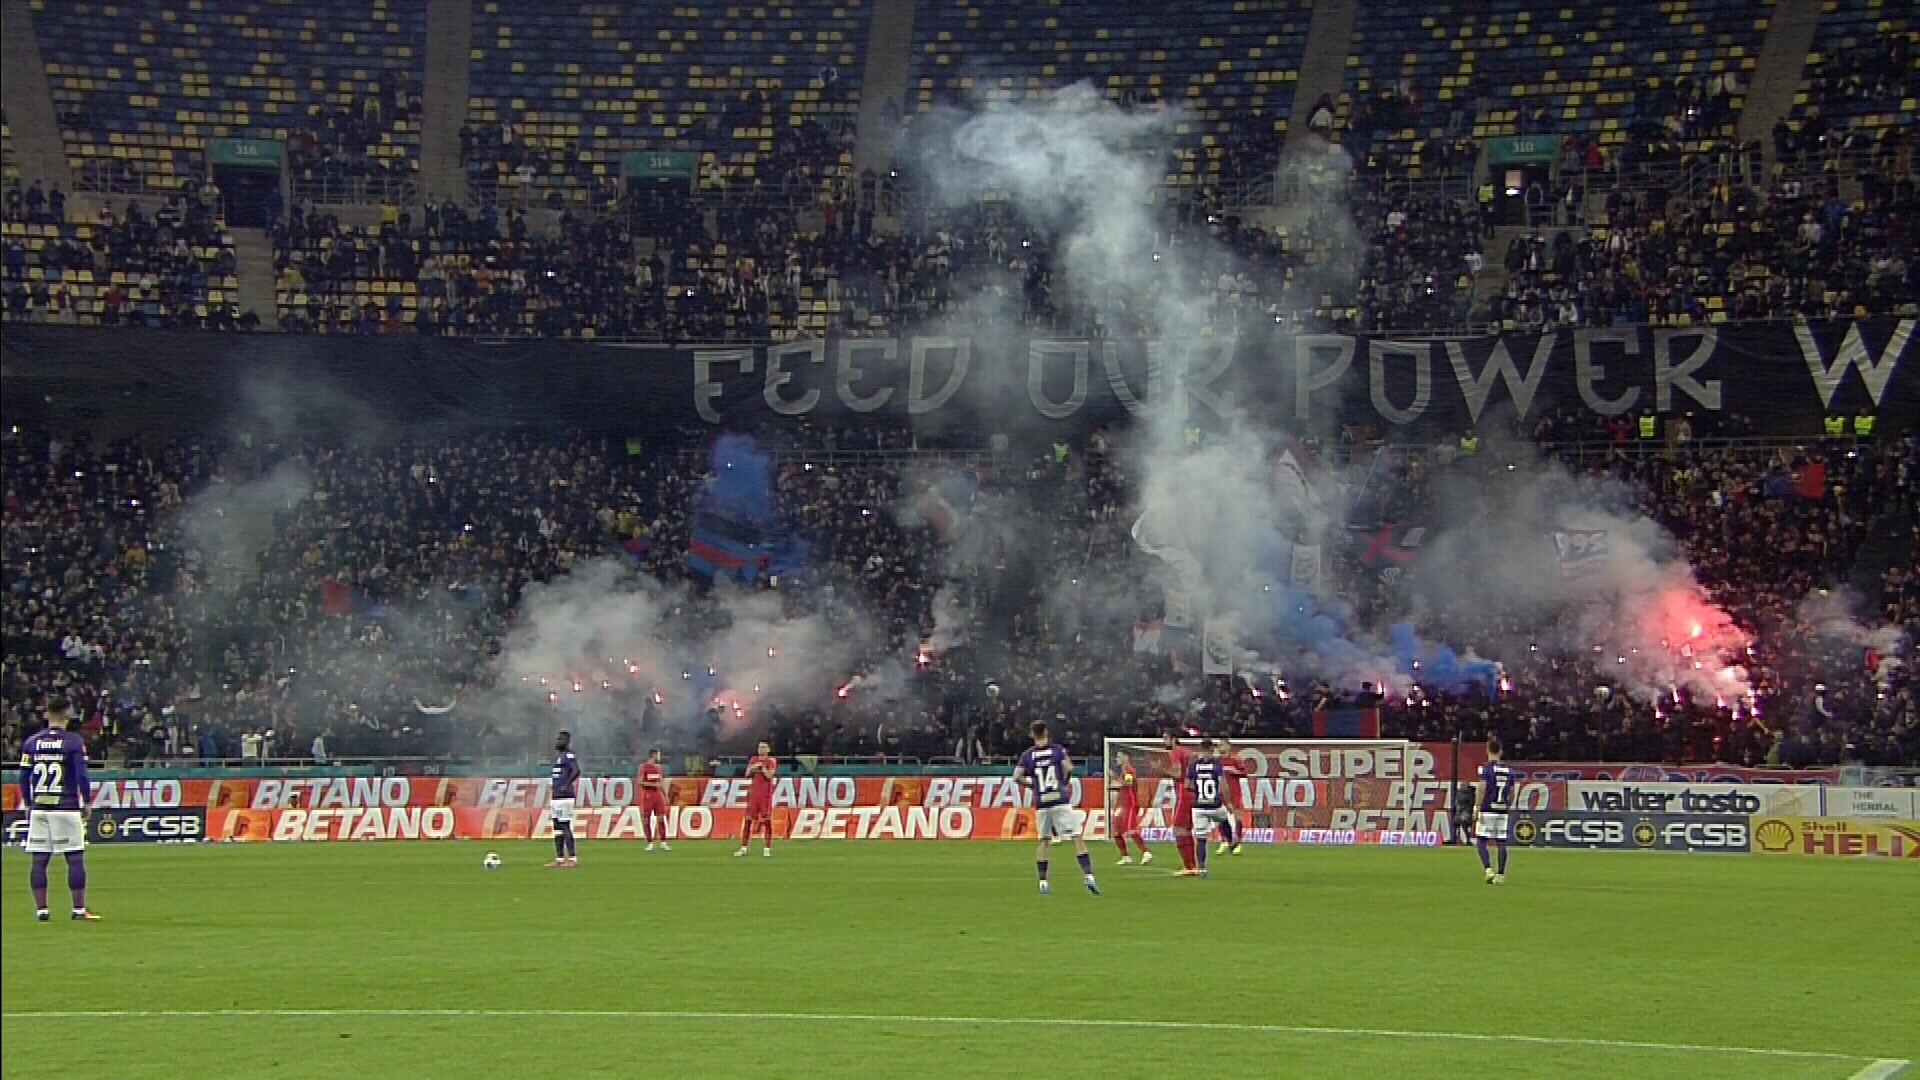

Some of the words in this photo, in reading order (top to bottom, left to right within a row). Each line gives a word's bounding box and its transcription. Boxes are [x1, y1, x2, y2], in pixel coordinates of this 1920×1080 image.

[693, 336, 971, 424] FEED
[1294, 326, 1722, 424] POWER
[1278, 747, 1436, 779] SUPER
[33, 763, 62, 793] 22
[1034, 766, 1058, 793] 14
[1196, 779, 1217, 799] 10
[1496, 781, 1507, 803] 7
[251, 778, 411, 808] BETANO
[479, 777, 634, 808] BETNO
[702, 777, 856, 808] BEANO
[1579, 785, 1675, 812] walter
[1681, 788, 1761, 814] tosto
[118, 815, 200, 837] FCSB
[272, 807, 454, 839] BETANO
[790, 806, 974, 839] BETANO
[1299, 829, 1355, 844] BETANO
[1540, 819, 1625, 843] FCSB
[1660, 819, 1747, 845] FCSB
[1802, 821, 1847, 832] Shell
[1803, 830, 1920, 858] HELI
